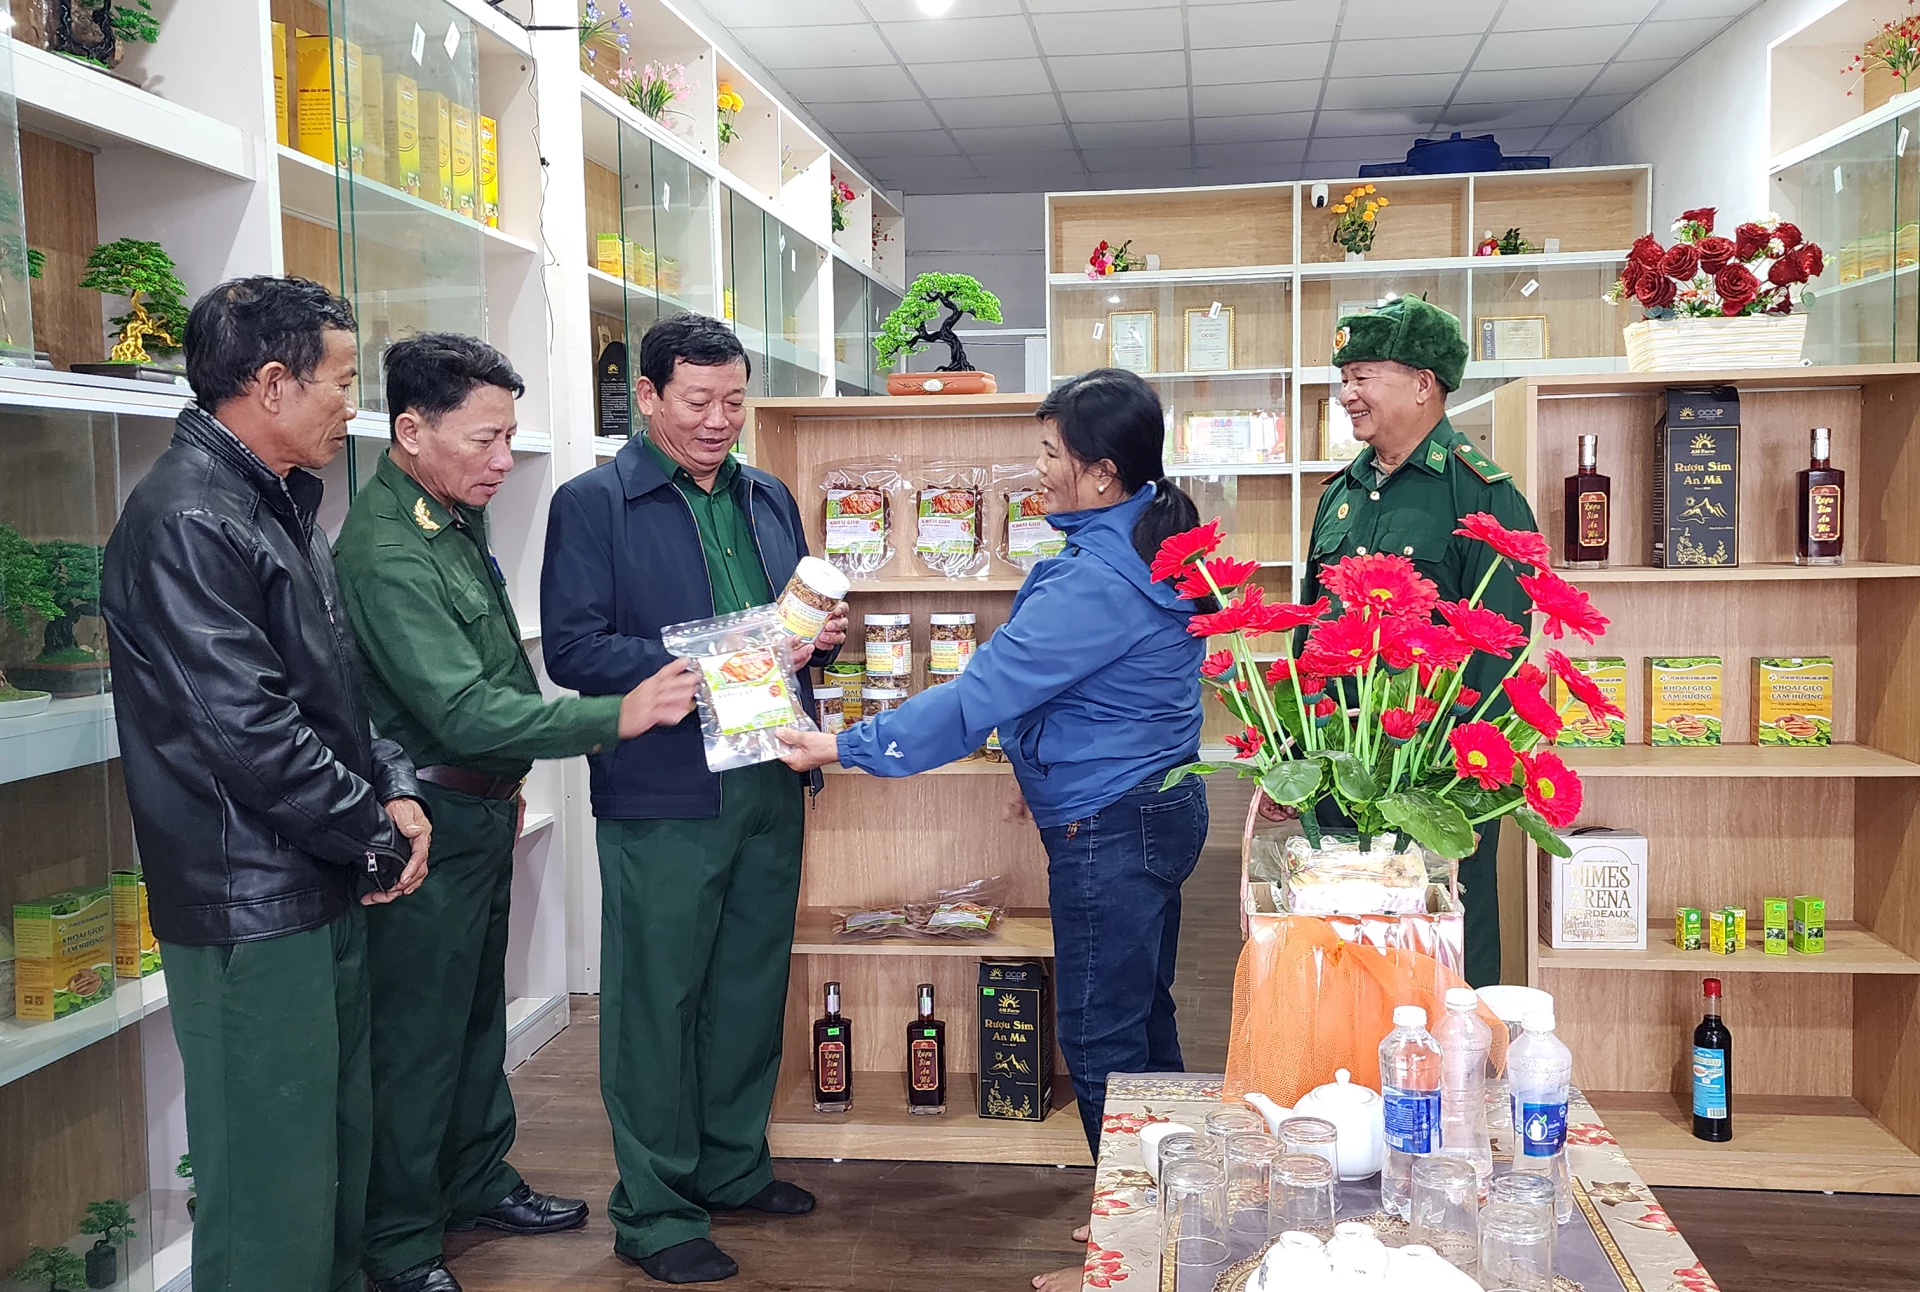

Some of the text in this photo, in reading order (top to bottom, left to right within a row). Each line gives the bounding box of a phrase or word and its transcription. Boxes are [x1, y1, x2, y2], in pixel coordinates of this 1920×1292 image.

[1698, 408, 1724, 416] OCOP
[1674, 462, 1732, 474] Rượu Sim
[1683, 475, 1723, 484] An Mã
[1570, 865, 1631, 888] NIMES
[1569, 889, 1631, 908] ARENA
[1569, 910, 1630, 918] BORDEAUX
[984, 1019, 1034, 1031] Rượu Sim
[992, 1032, 1027, 1042] An Mã
